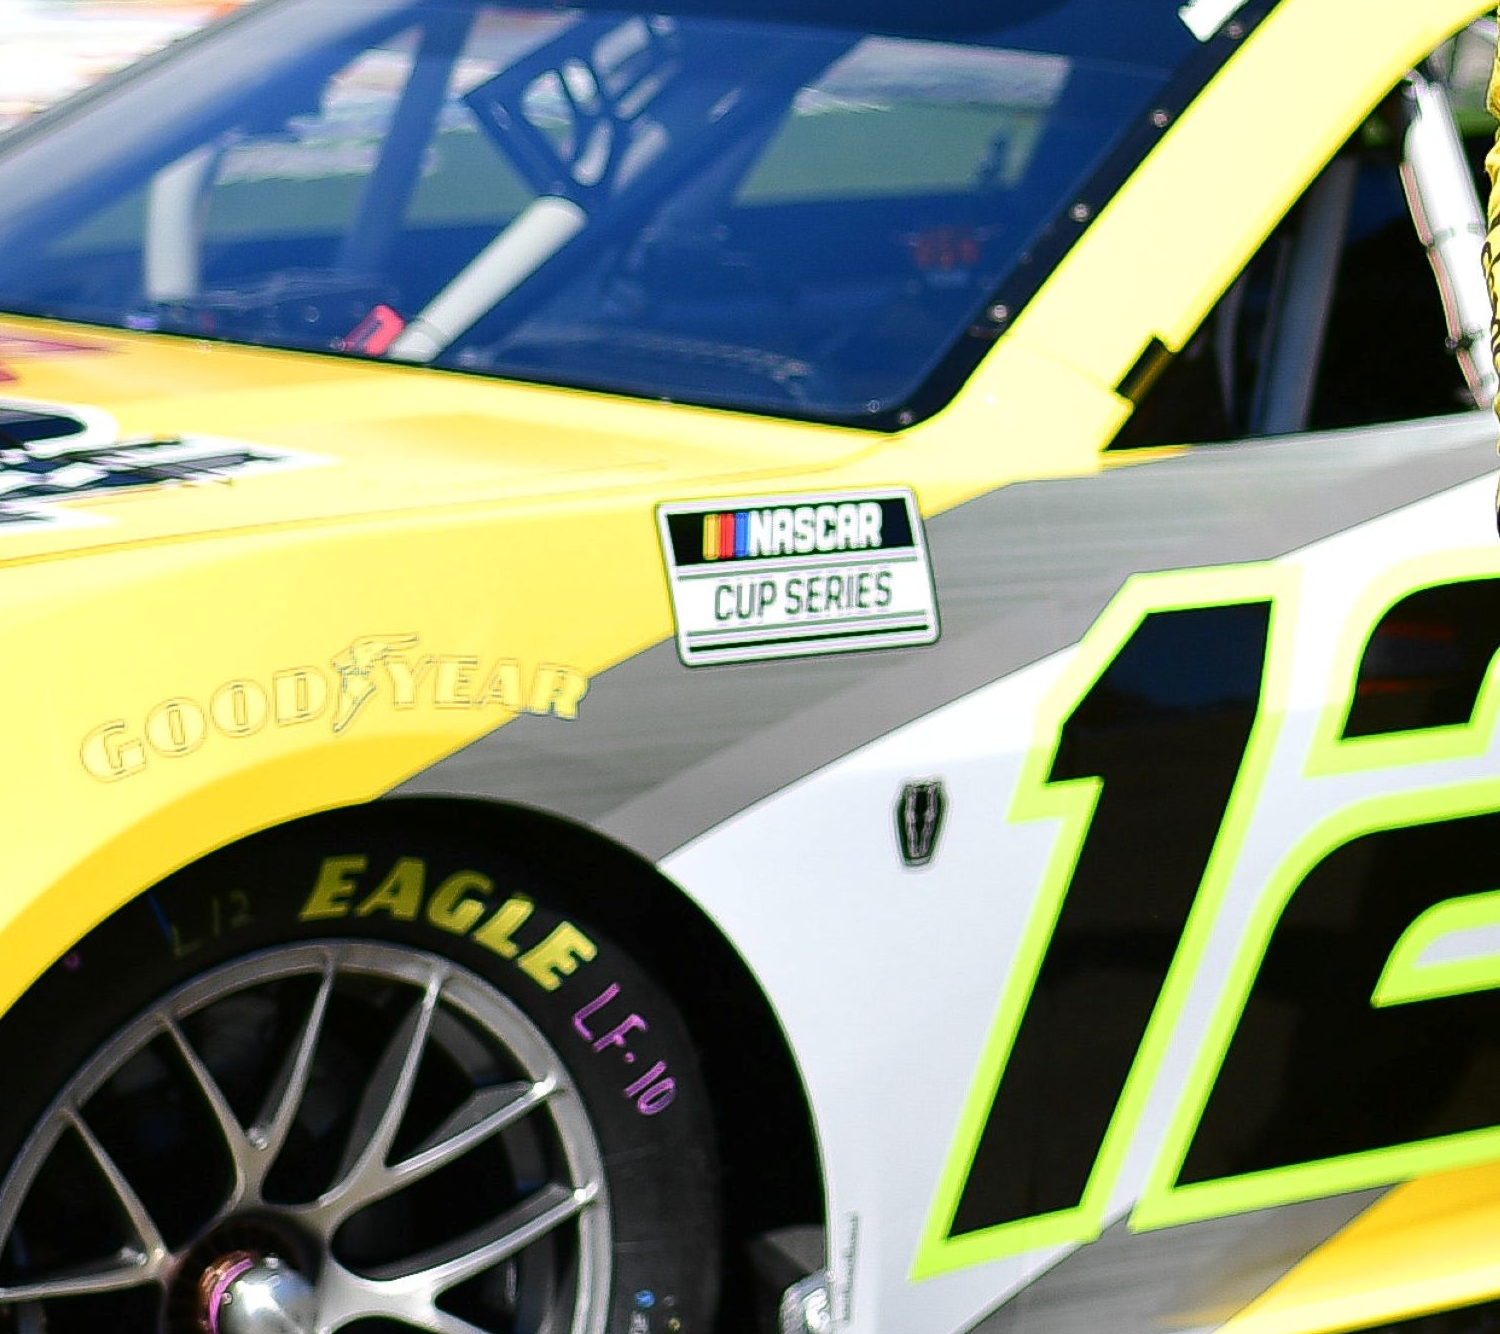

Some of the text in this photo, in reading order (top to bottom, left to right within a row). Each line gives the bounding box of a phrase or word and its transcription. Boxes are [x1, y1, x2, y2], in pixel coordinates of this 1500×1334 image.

[749, 501, 884, 557] NASCAR
[714, 569, 895, 622] CUP SERIES
[79, 633, 592, 783] GOODYEAR
[298, 855, 599, 992] EAGLE
